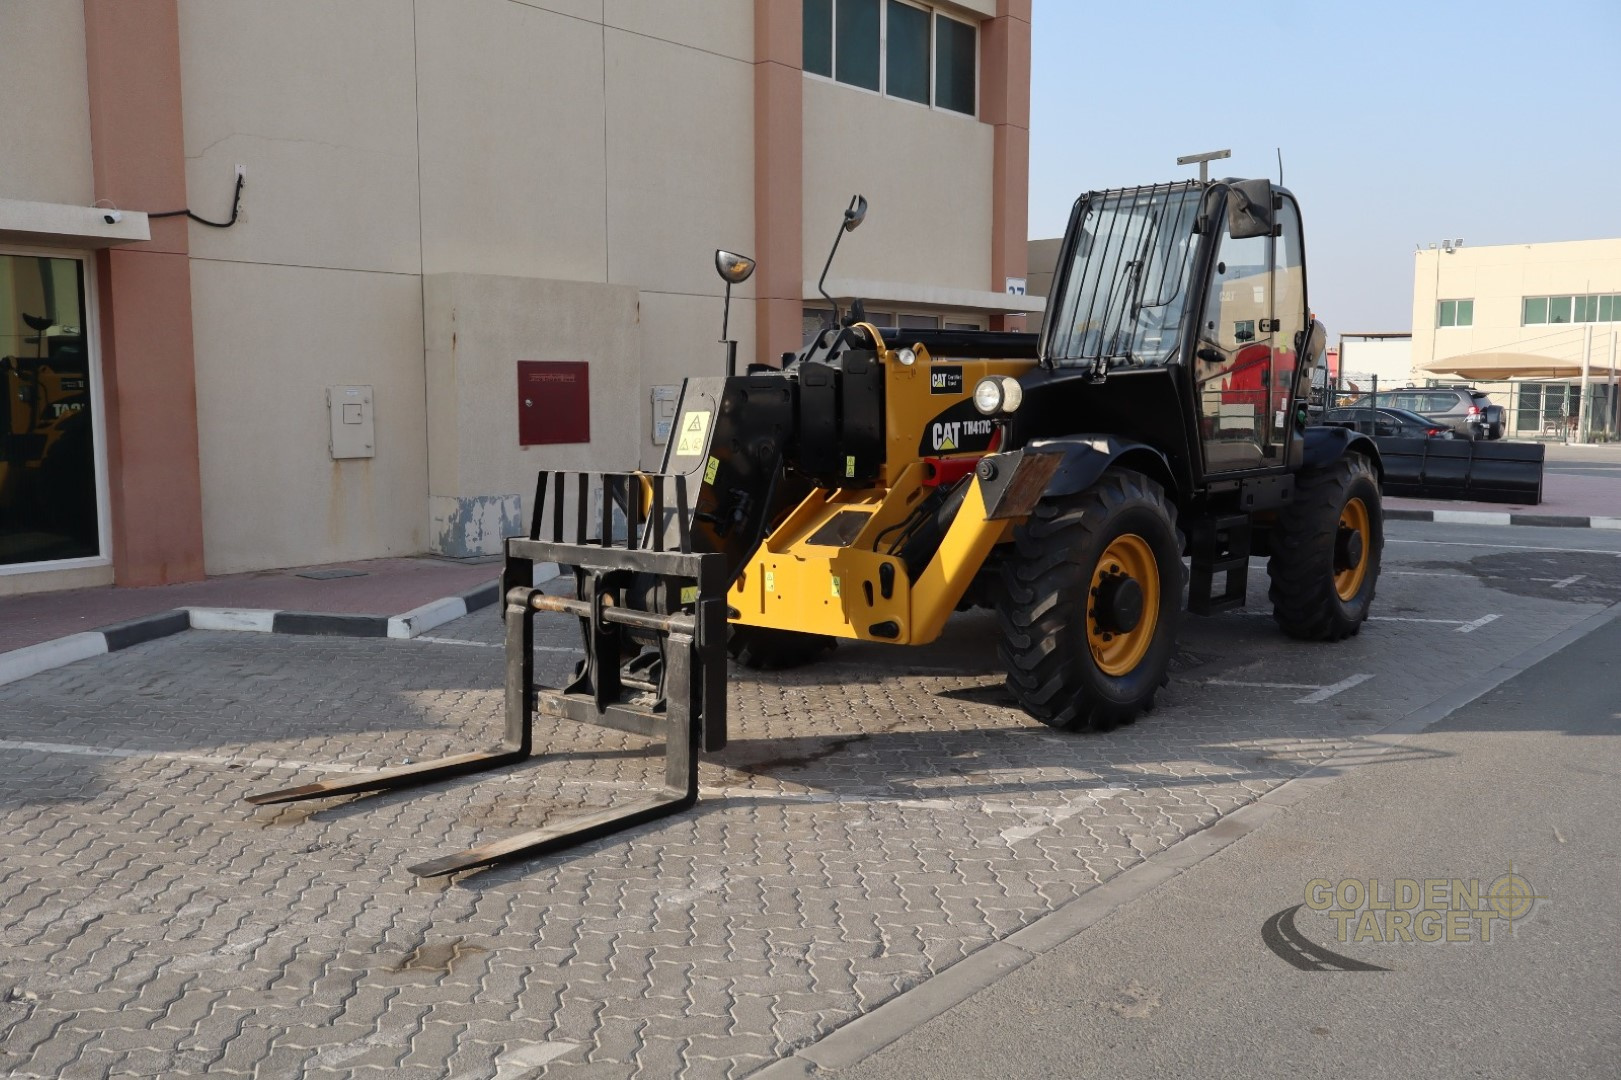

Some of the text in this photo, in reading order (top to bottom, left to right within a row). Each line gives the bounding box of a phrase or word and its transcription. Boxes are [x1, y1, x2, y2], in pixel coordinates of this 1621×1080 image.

[932, 373, 947, 388] CAT
[932, 420, 991, 451] CAT TH417C
